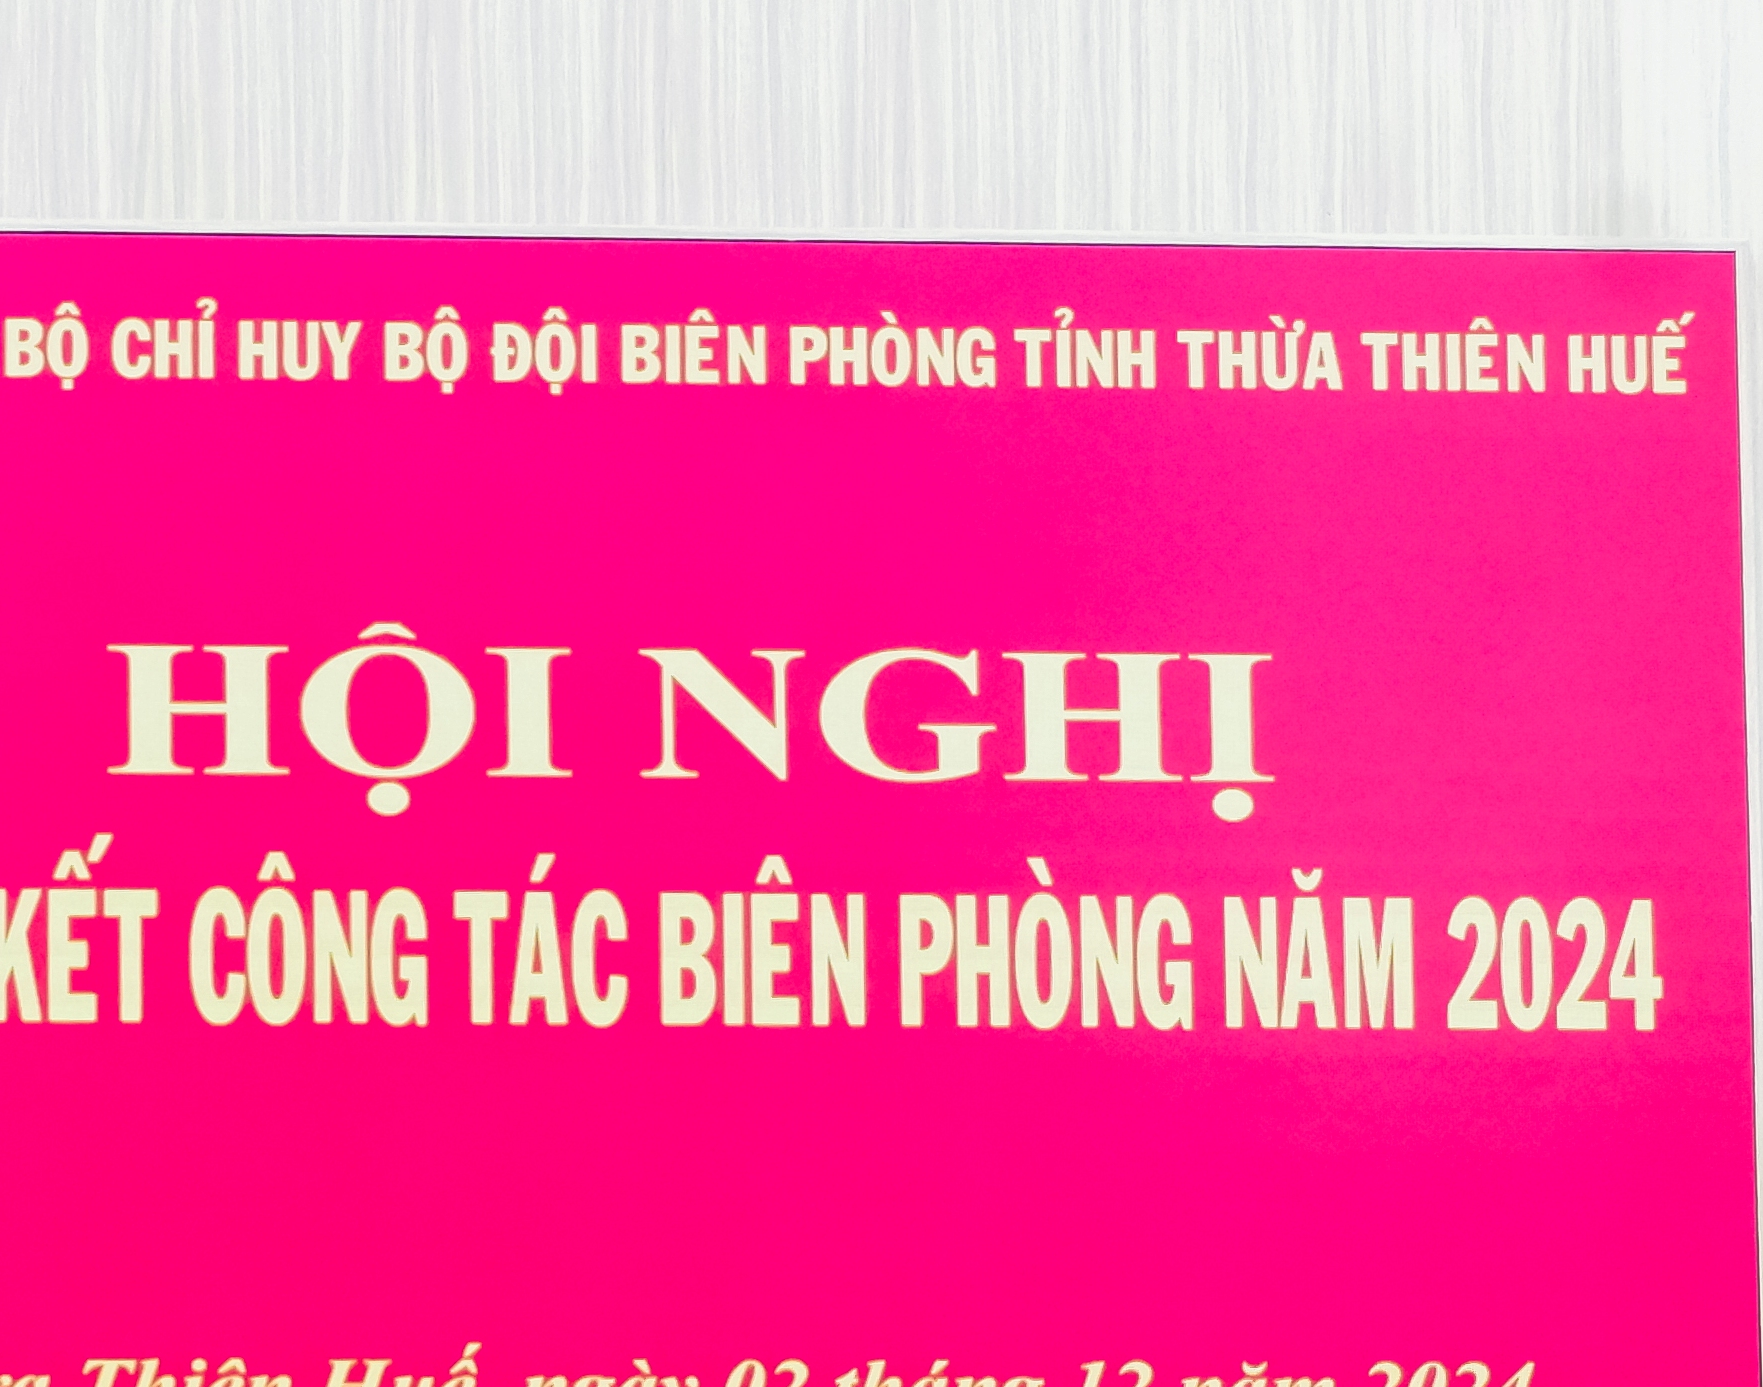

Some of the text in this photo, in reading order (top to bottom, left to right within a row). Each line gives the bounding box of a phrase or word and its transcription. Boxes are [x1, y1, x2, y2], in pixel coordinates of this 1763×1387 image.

[4, 302, 89, 390] BỘ
[111, 297, 217, 379] CHỈ
[238, 320, 362, 381] HUY
[384, 306, 468, 394] BỘ
[490, 307, 598, 395] ĐỘI
[621, 308, 767, 384] BIÊN
[789, 311, 997, 388] PHÒNG
[1014, 306, 1156, 389] TỈNH
[1177, 315, 1343, 391] THỪA
[1360, 316, 1546, 392] THIÊN
[1568, 311, 1695, 395] HUẾ
[107, 622, 1275, 822] HỘI NGHỊ
[189, 851, 428, 1027] CÔNG
[453, 853, 628, 1028] TÁC
[660, 855, 866, 1027] BIÊN
[899, 857, 1194, 1031] PHÒNG
[1223, 868, 1415, 1030] NĂM
[1447, 895, 1664, 1032] 2024
